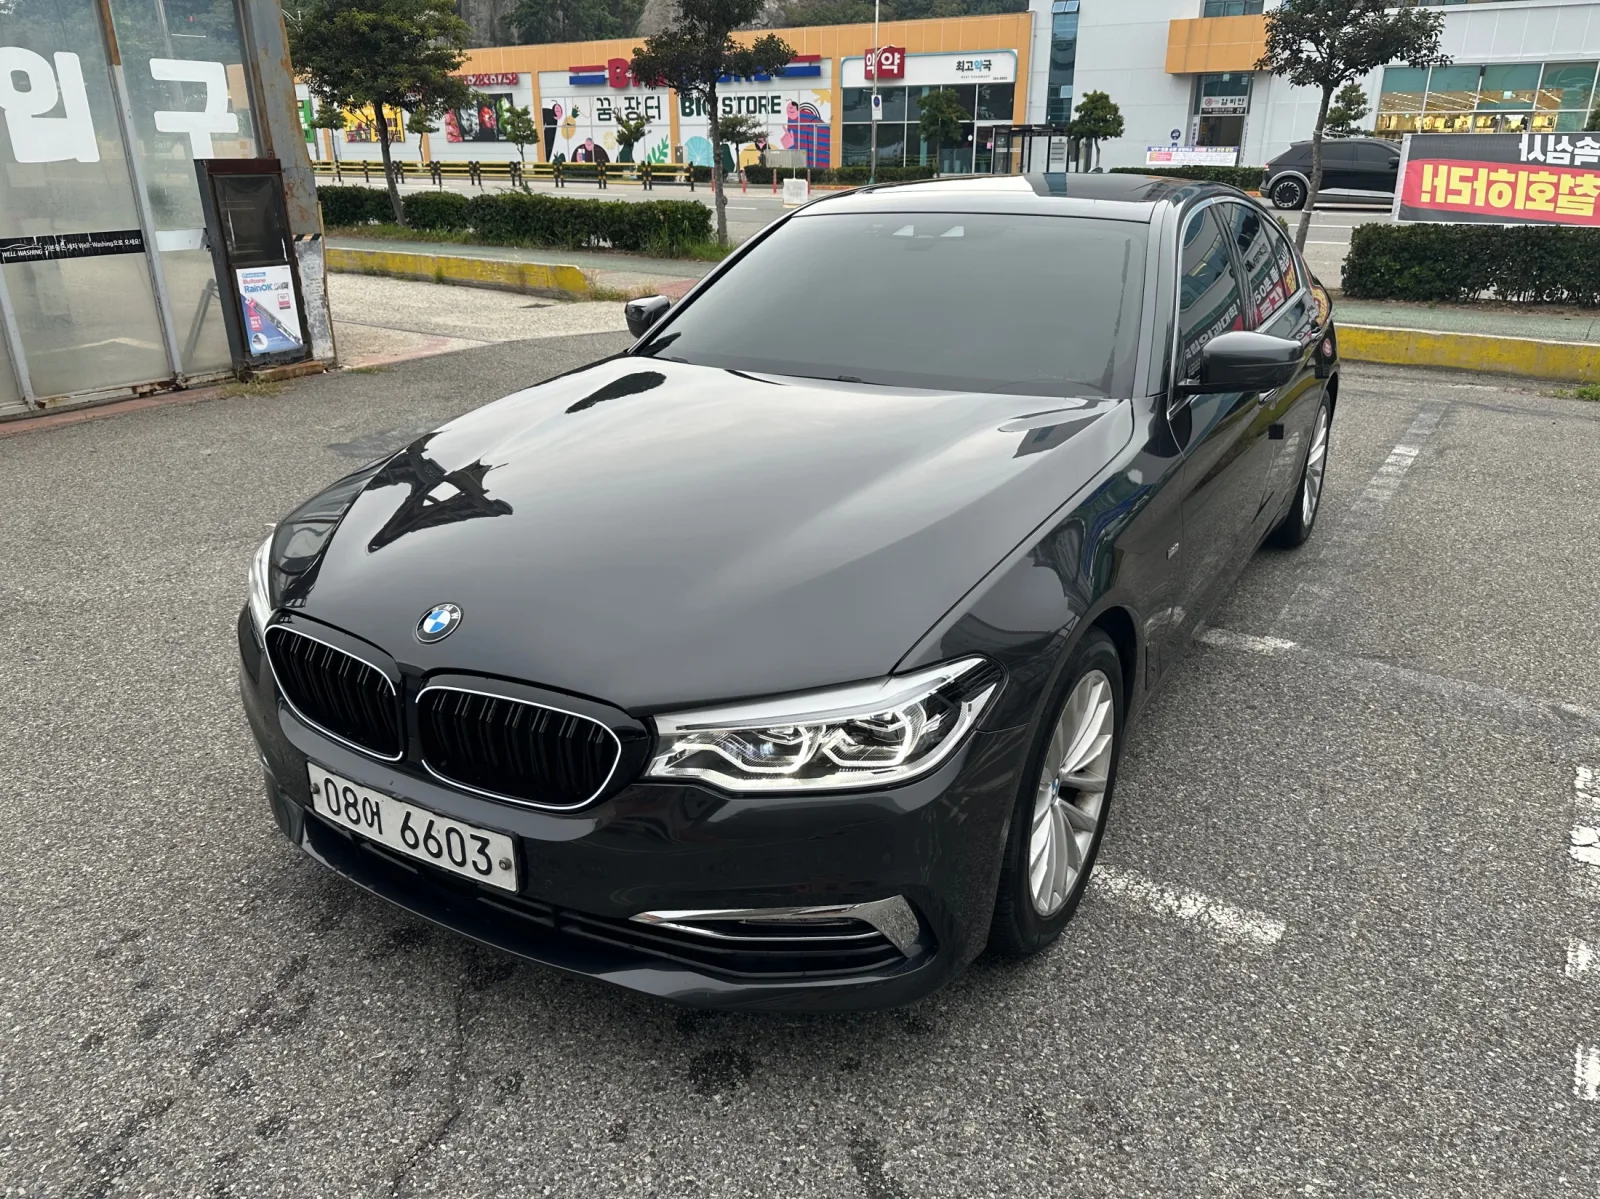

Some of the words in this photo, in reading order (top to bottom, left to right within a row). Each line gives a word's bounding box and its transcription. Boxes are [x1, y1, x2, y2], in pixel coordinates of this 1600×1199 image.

[880, 52, 901, 74] 약
[956, 59, 992, 73] 최고약국
[624, 95, 661, 121] 장터
[721, 95, 782, 115] STORE
[244, 284, 272, 294] RainOK
[323, 777, 384, 836] 08어
[400, 810, 493, 876] 6603
